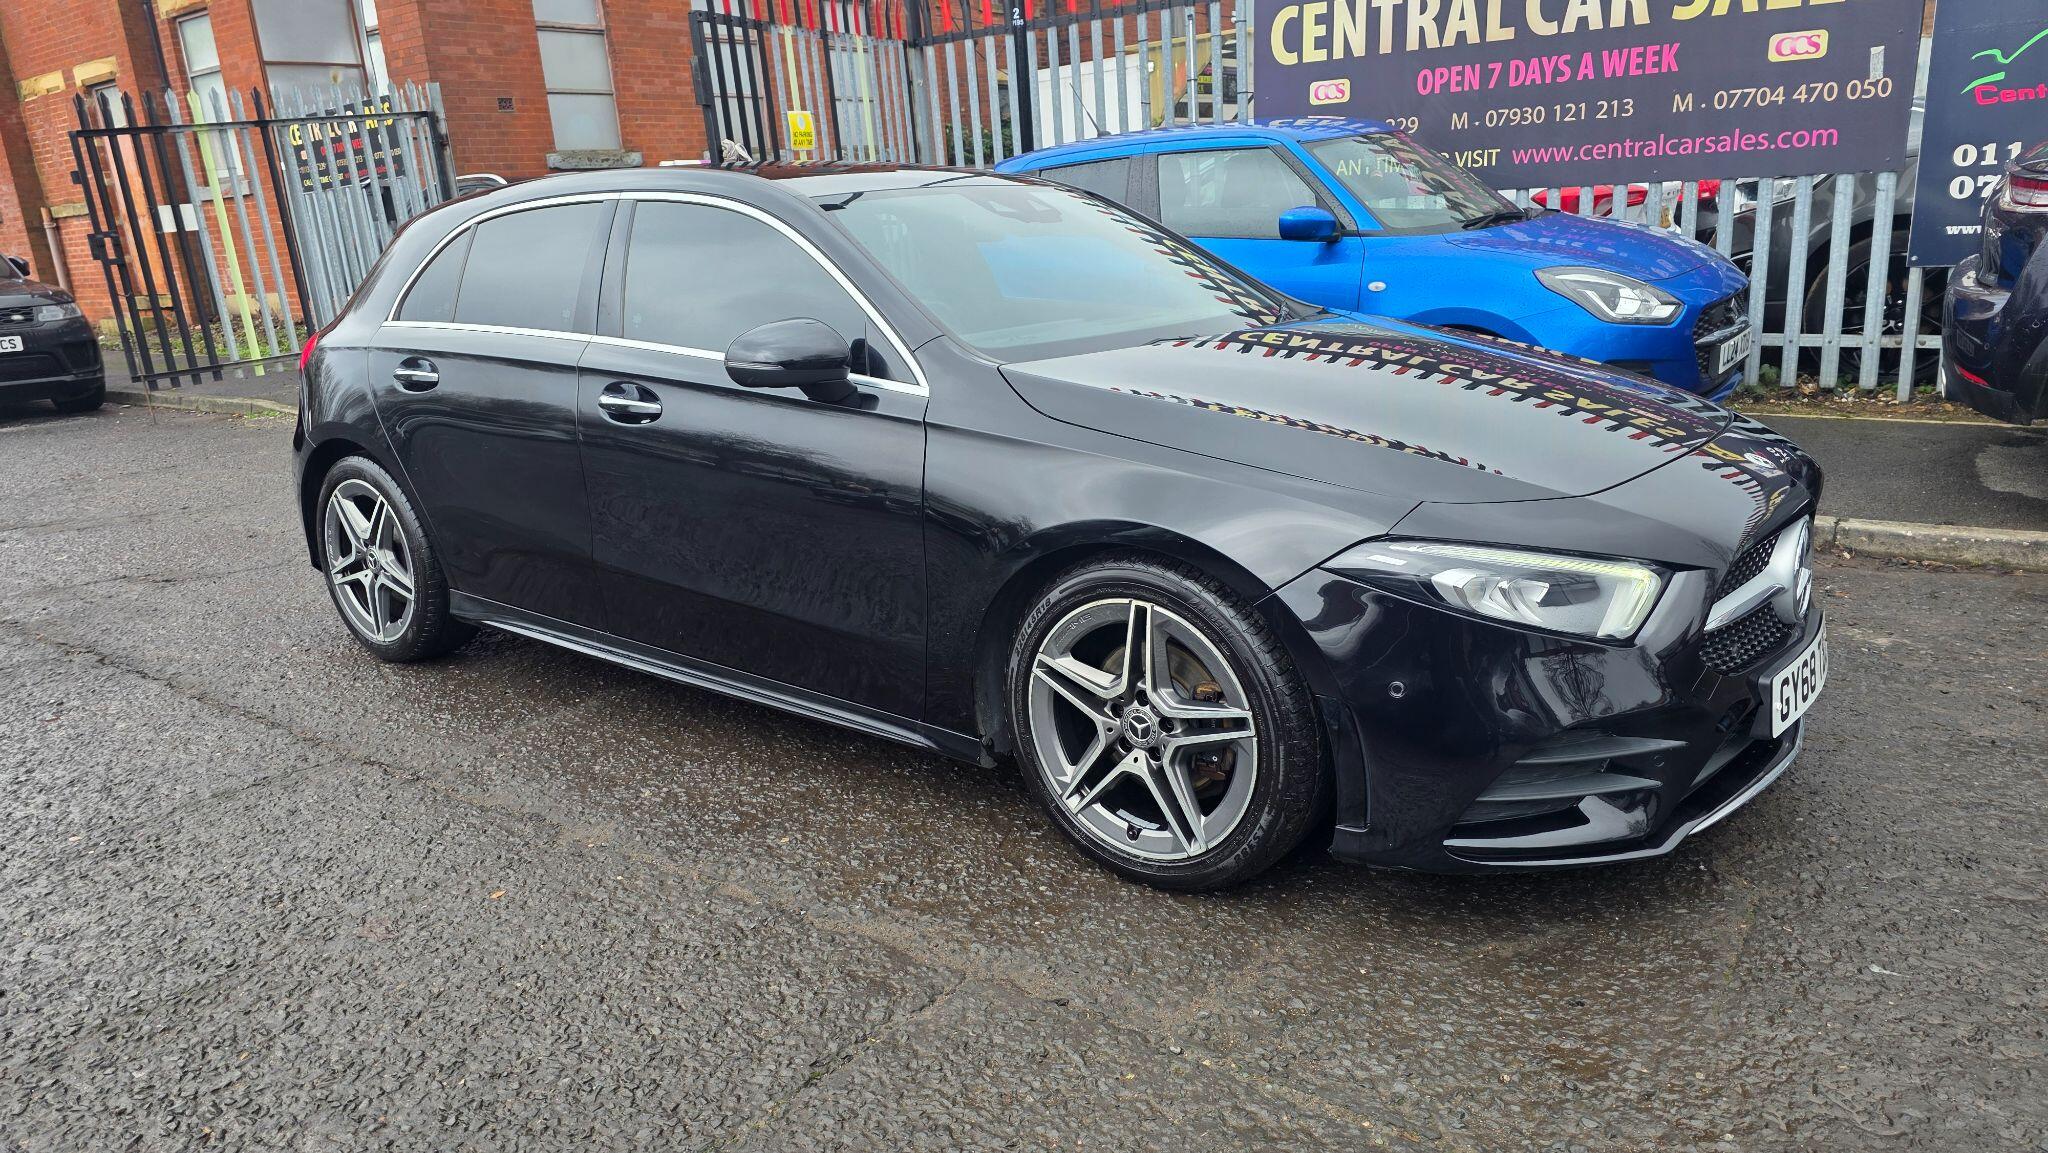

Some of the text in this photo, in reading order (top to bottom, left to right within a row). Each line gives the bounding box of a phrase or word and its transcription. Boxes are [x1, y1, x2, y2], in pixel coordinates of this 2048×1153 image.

[1012, 8, 1019, 19] 2
[1271, 0, 1515, 65] CENTRAL
[1417, 43, 1680, 95] OPEN 7 DAYS A WEEK
[1451, 112, 1468, 130] M
[1485, 106, 1545, 128] 07930
[1553, 102, 1586, 122] 121
[1595, 98, 1634, 119] 213
[1672, 92, 1693, 113] M
[1714, 85, 1785, 110] 07704
[1792, 81, 1838, 104] 470
[1846, 77, 1893, 100] 050
[1455, 148, 1501, 168] VISIT
[1512, 128, 1839, 165] www.centralcarsales.com
[1781, 650, 1817, 722] GY68
